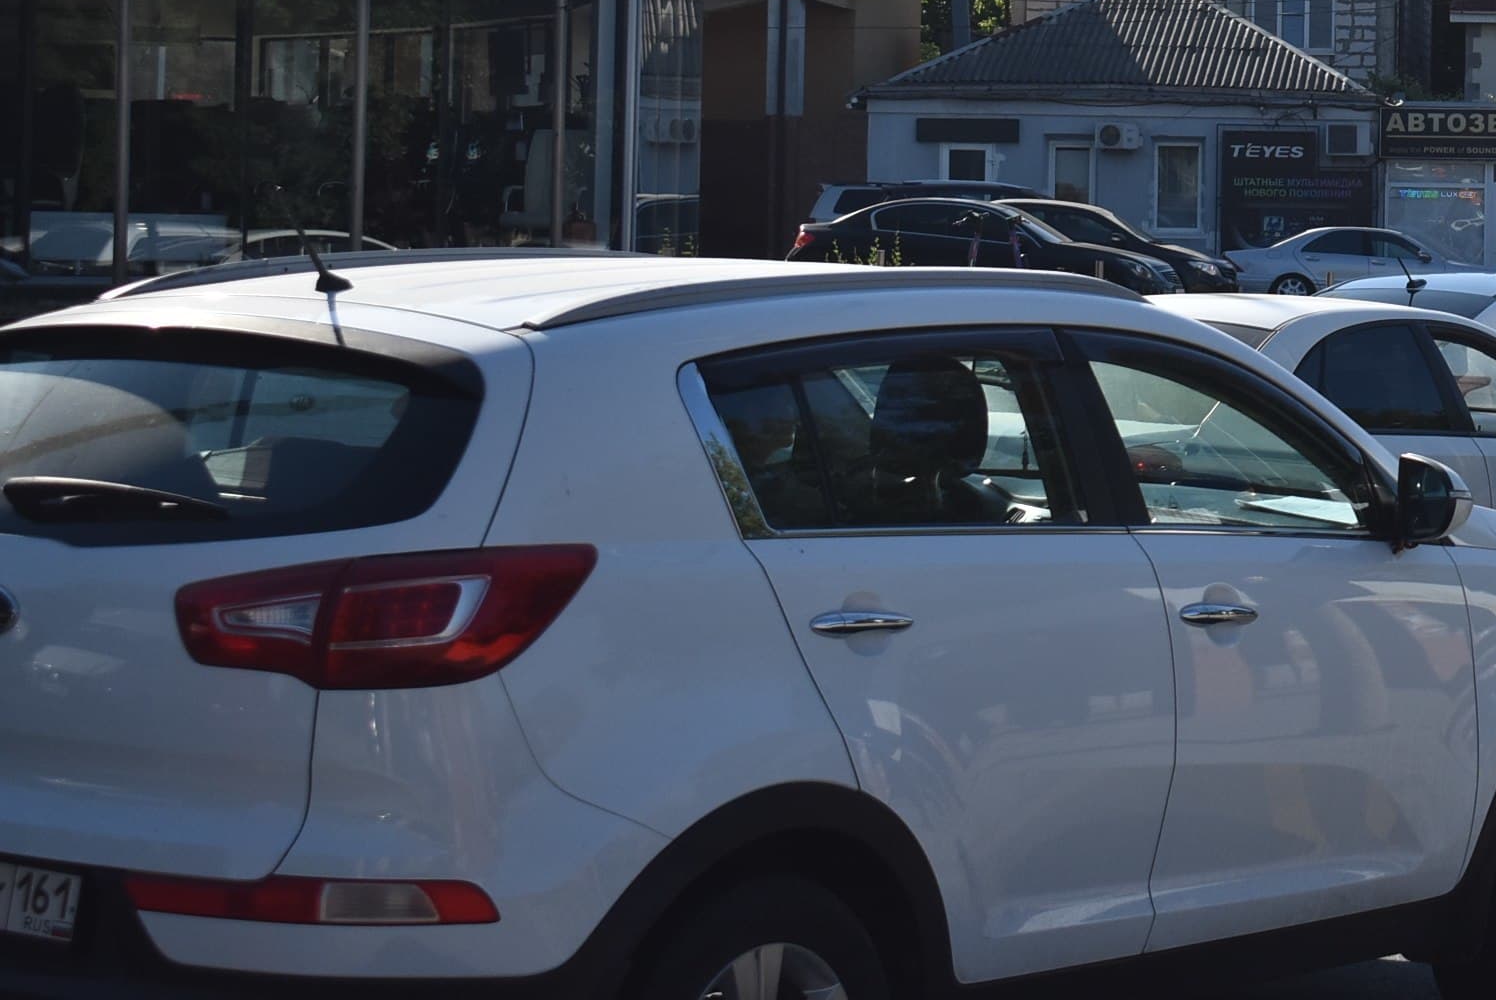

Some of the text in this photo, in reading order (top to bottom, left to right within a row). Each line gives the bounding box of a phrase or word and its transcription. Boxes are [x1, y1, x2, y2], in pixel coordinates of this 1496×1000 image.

[1230, 142, 1305, 159] TEYES
[1423, 145, 1456, 154] POWER
[1233, 177, 1285, 187] ШТАТНЫЕ
[1243, 187, 1288, 198] НОВОГО
[17, 870, 73, 920] 161
[23, 915, 50, 935] RUS
